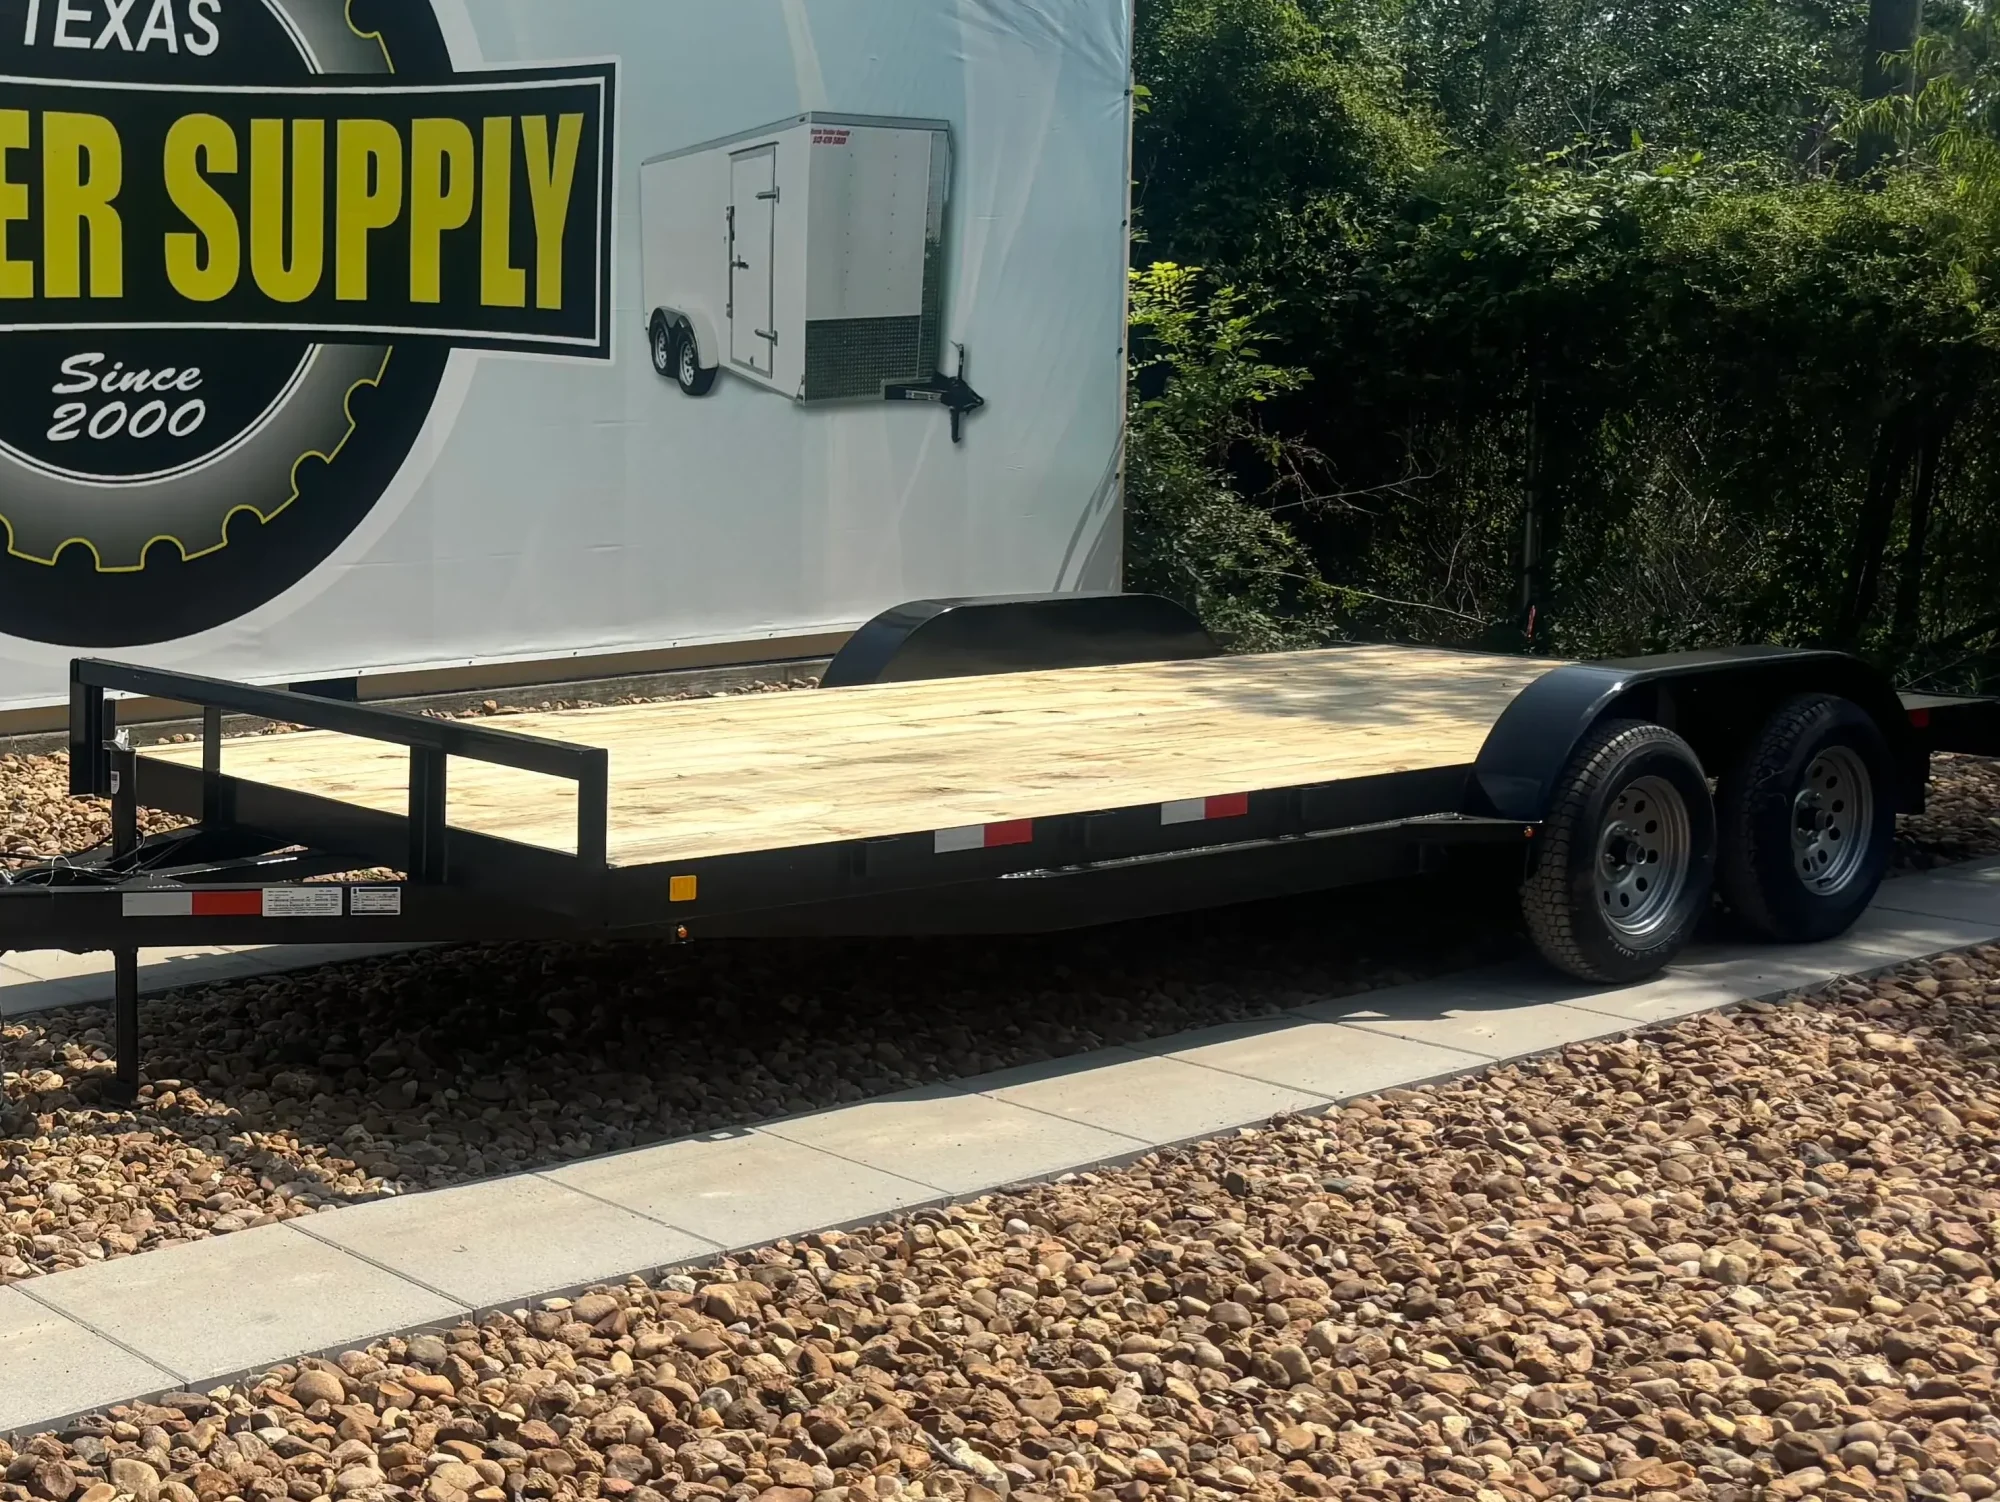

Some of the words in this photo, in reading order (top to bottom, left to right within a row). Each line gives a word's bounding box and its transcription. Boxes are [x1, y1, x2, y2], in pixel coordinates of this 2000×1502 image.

[164, 113, 584, 310] SUPPLY
[52, 352, 203, 394] Since
[46, 399, 206, 441] 2000
